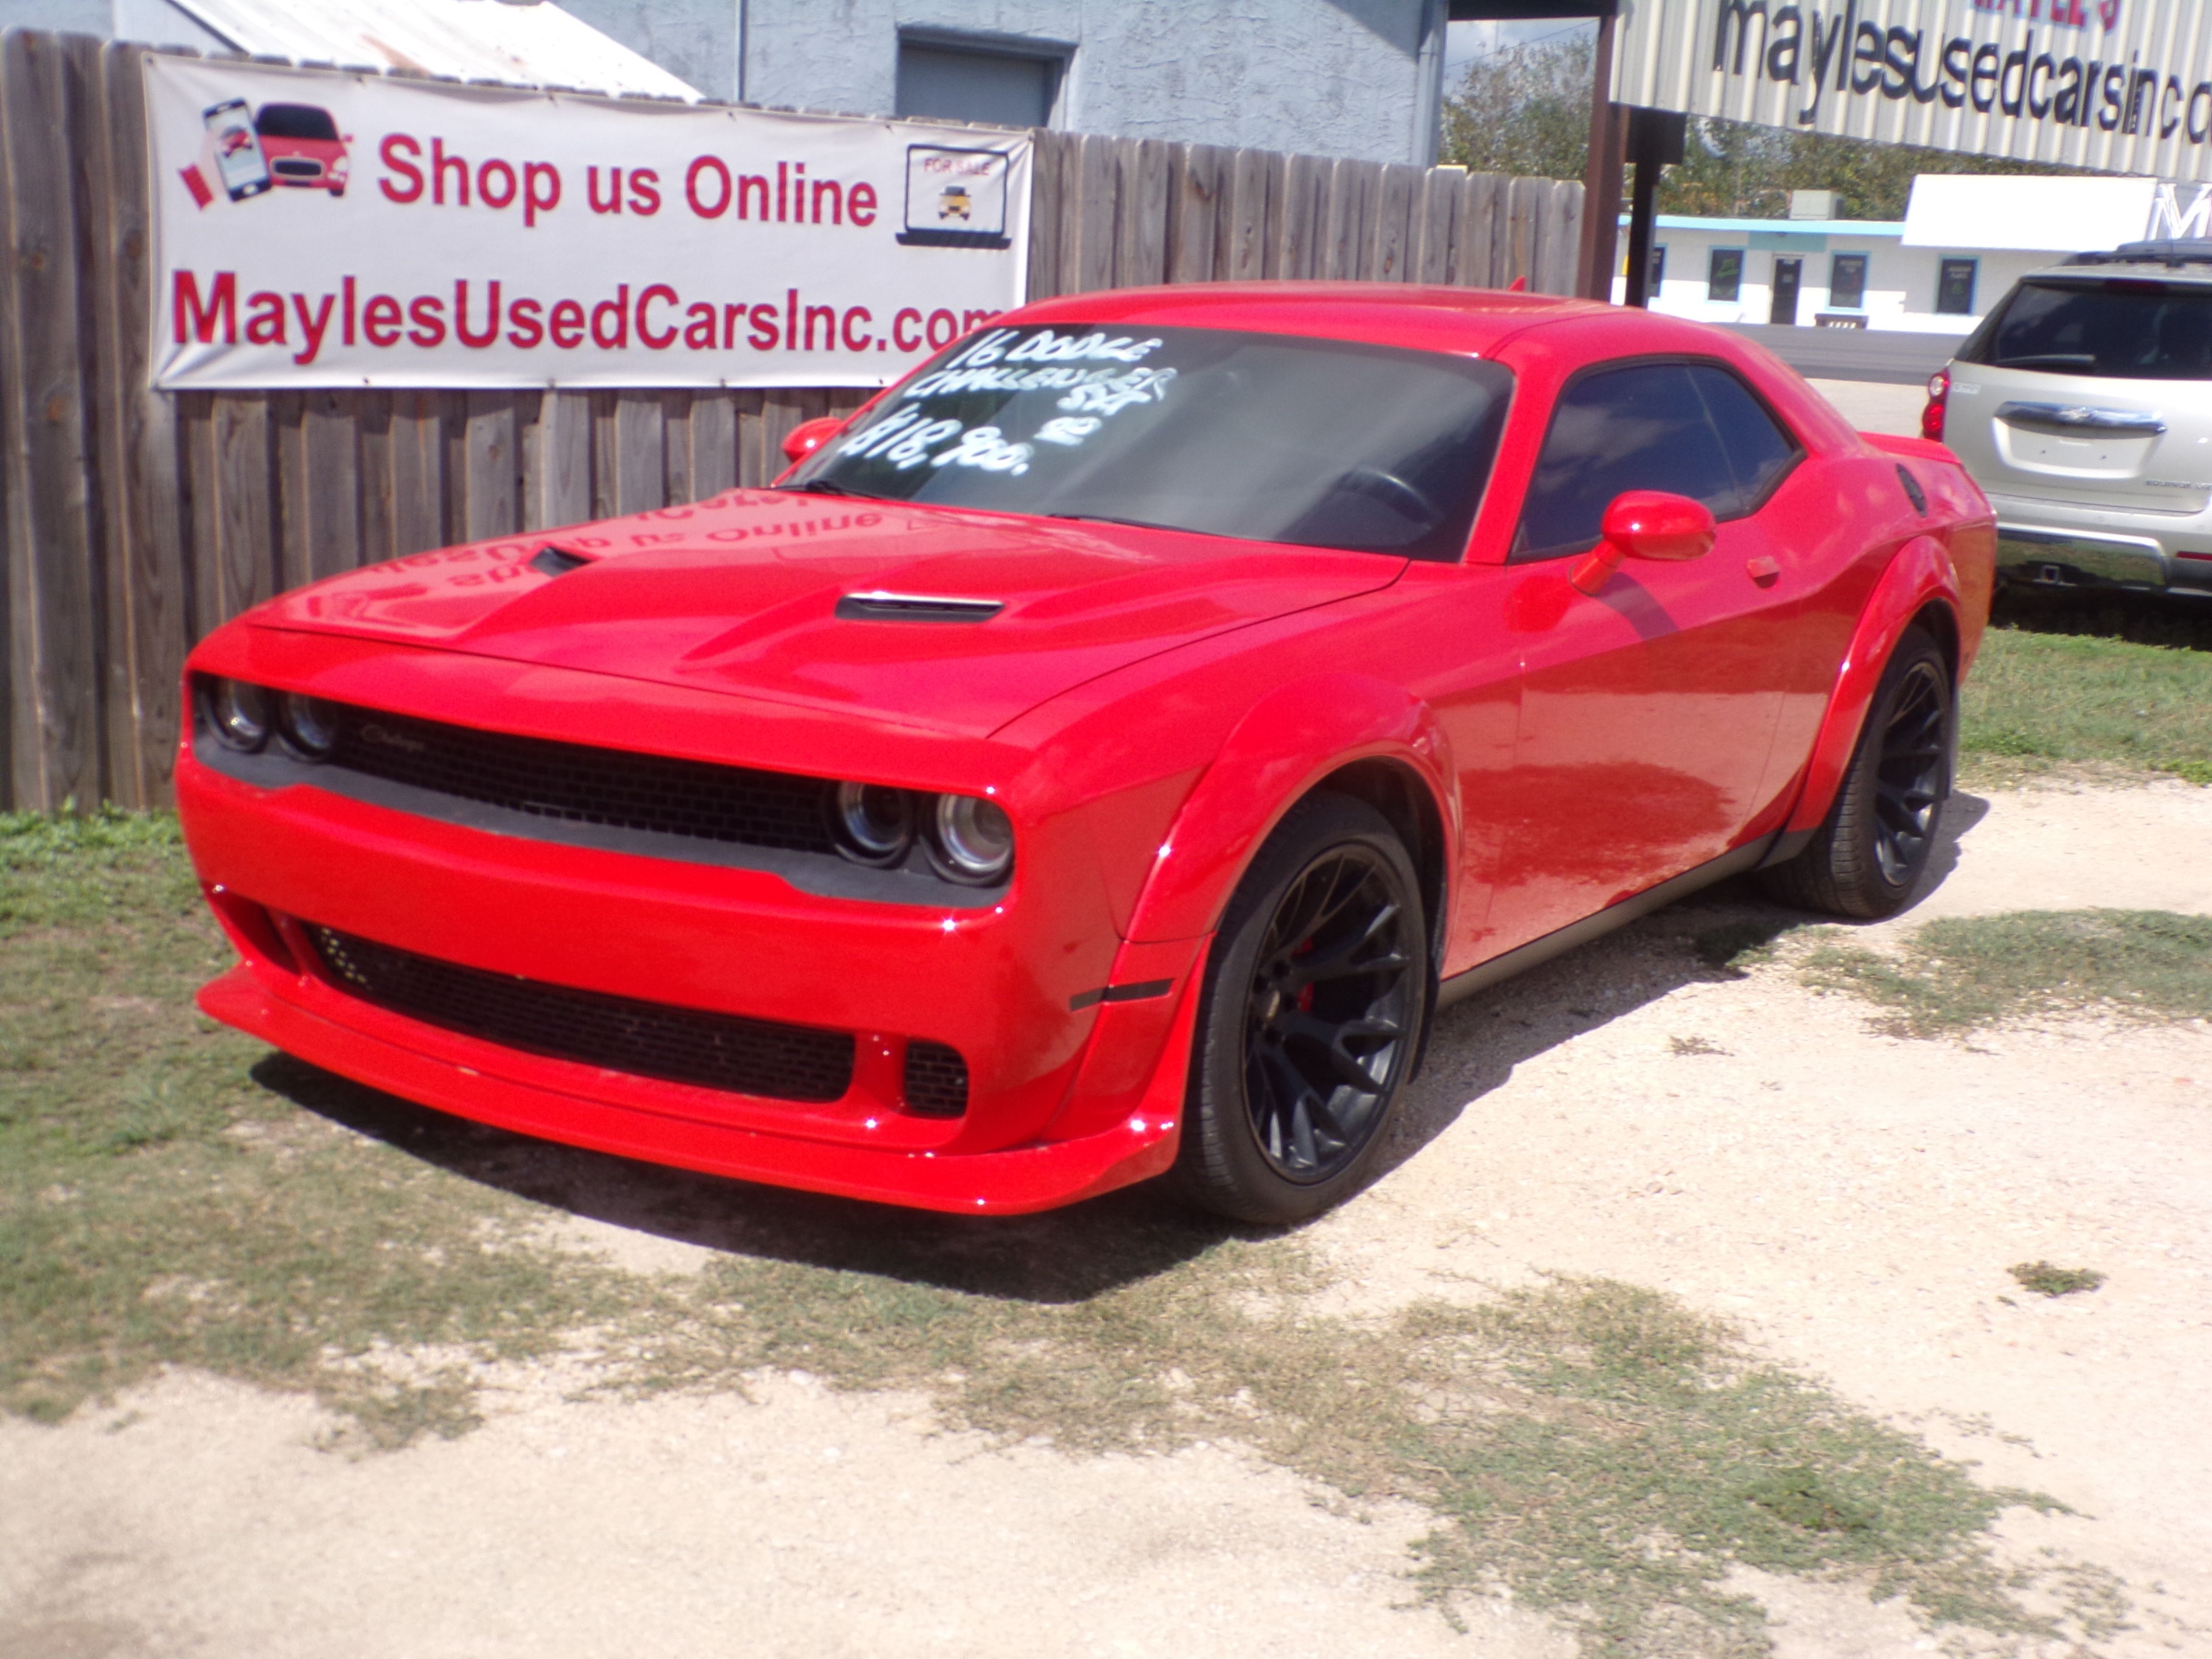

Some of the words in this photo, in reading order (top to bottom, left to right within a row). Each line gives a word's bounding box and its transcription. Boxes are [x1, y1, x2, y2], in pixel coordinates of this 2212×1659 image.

[379, 134, 561, 227] Shop
[588, 167, 661, 216] us
[685, 155, 878, 227] Online
[924, 156, 952, 173] FOR
[173, 270, 1003, 366] MaylesUsedCarsInc.co
[945, 328, 1020, 370] 16
[1004, 329, 1163, 364] DODGE
